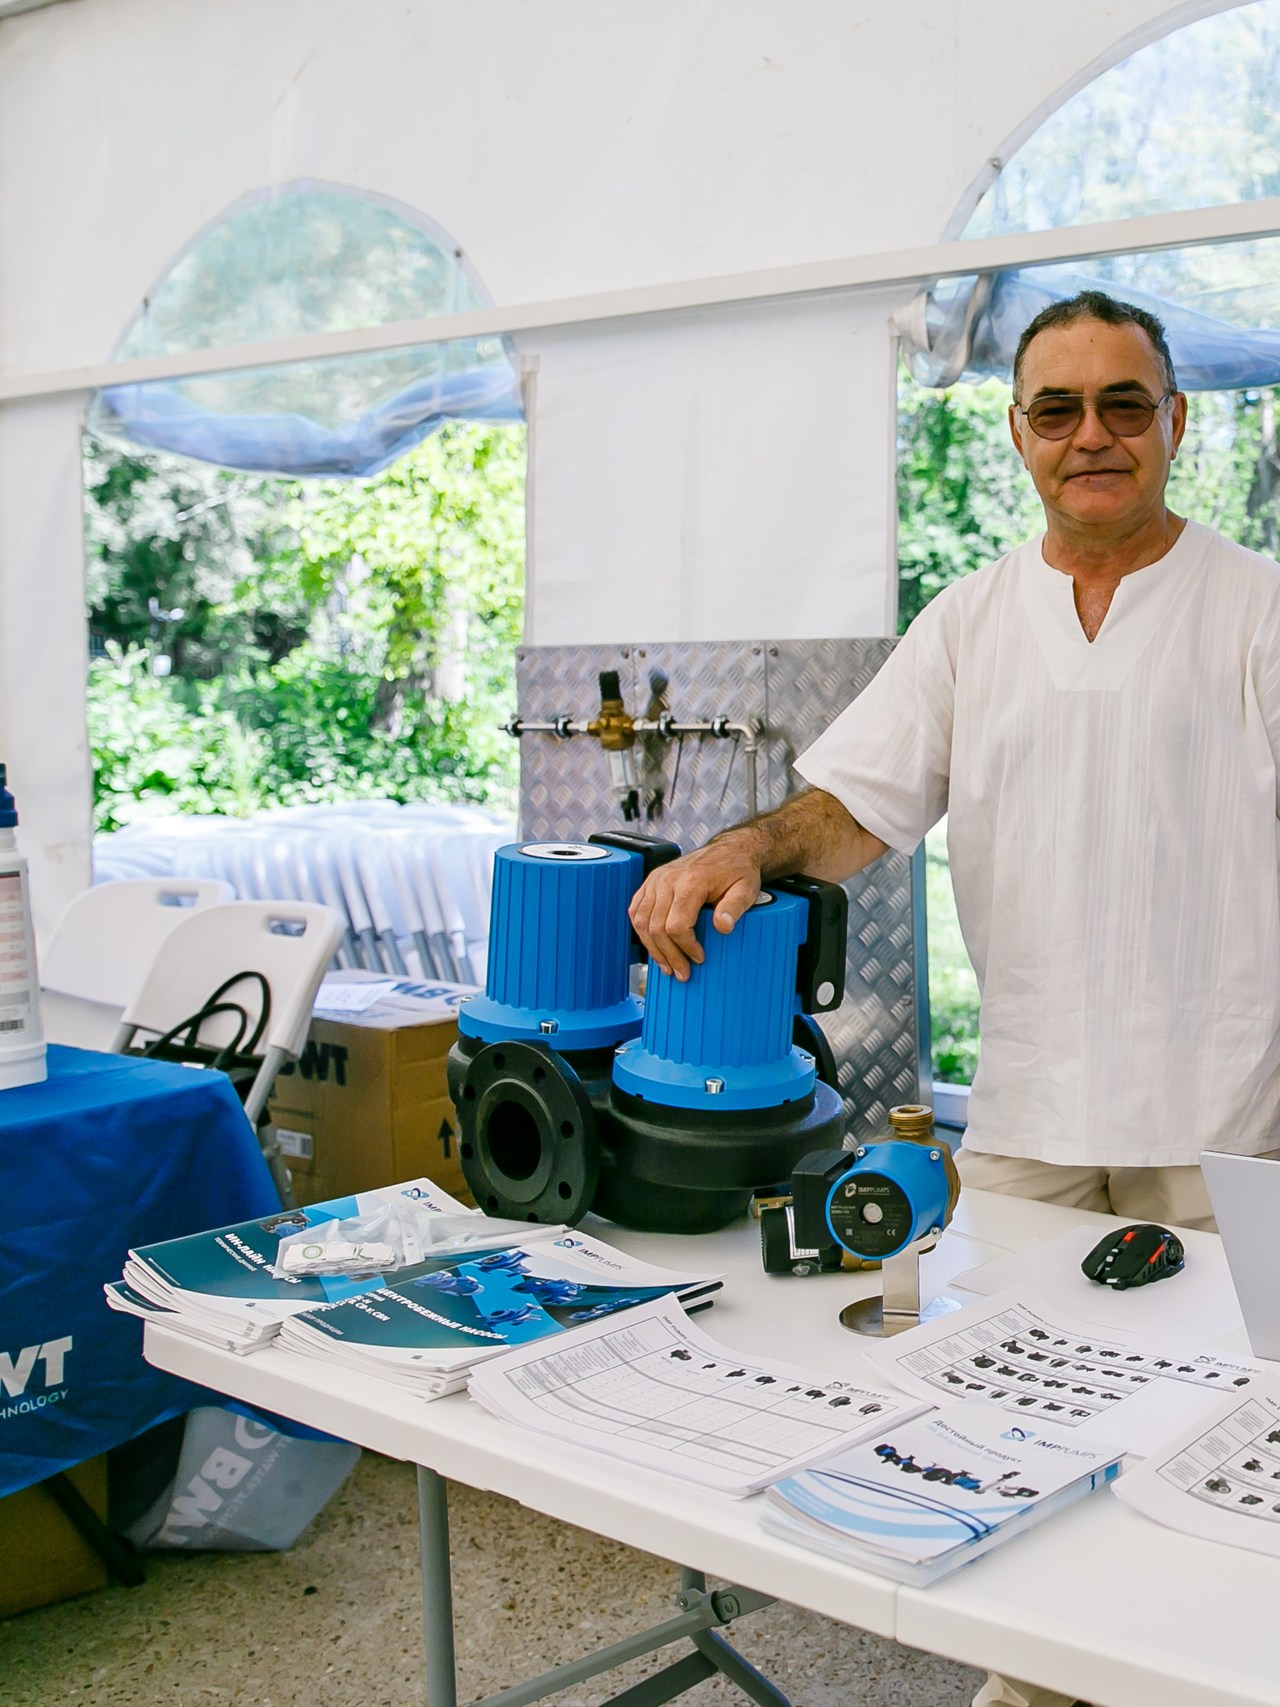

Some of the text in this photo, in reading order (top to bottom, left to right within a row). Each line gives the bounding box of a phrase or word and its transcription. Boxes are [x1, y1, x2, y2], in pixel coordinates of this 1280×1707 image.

[278, 1040, 348, 1086] WT
[224, 1233, 303, 1284] ИН-ЛАЙН НАСЫ
[376, 1287, 462, 1330] ЦЕНТРОБЕЖНЫЕ
[459, 1326, 509, 1339] НАСОСЫ
[932, 1419, 1023, 1464] Достойный продукт
